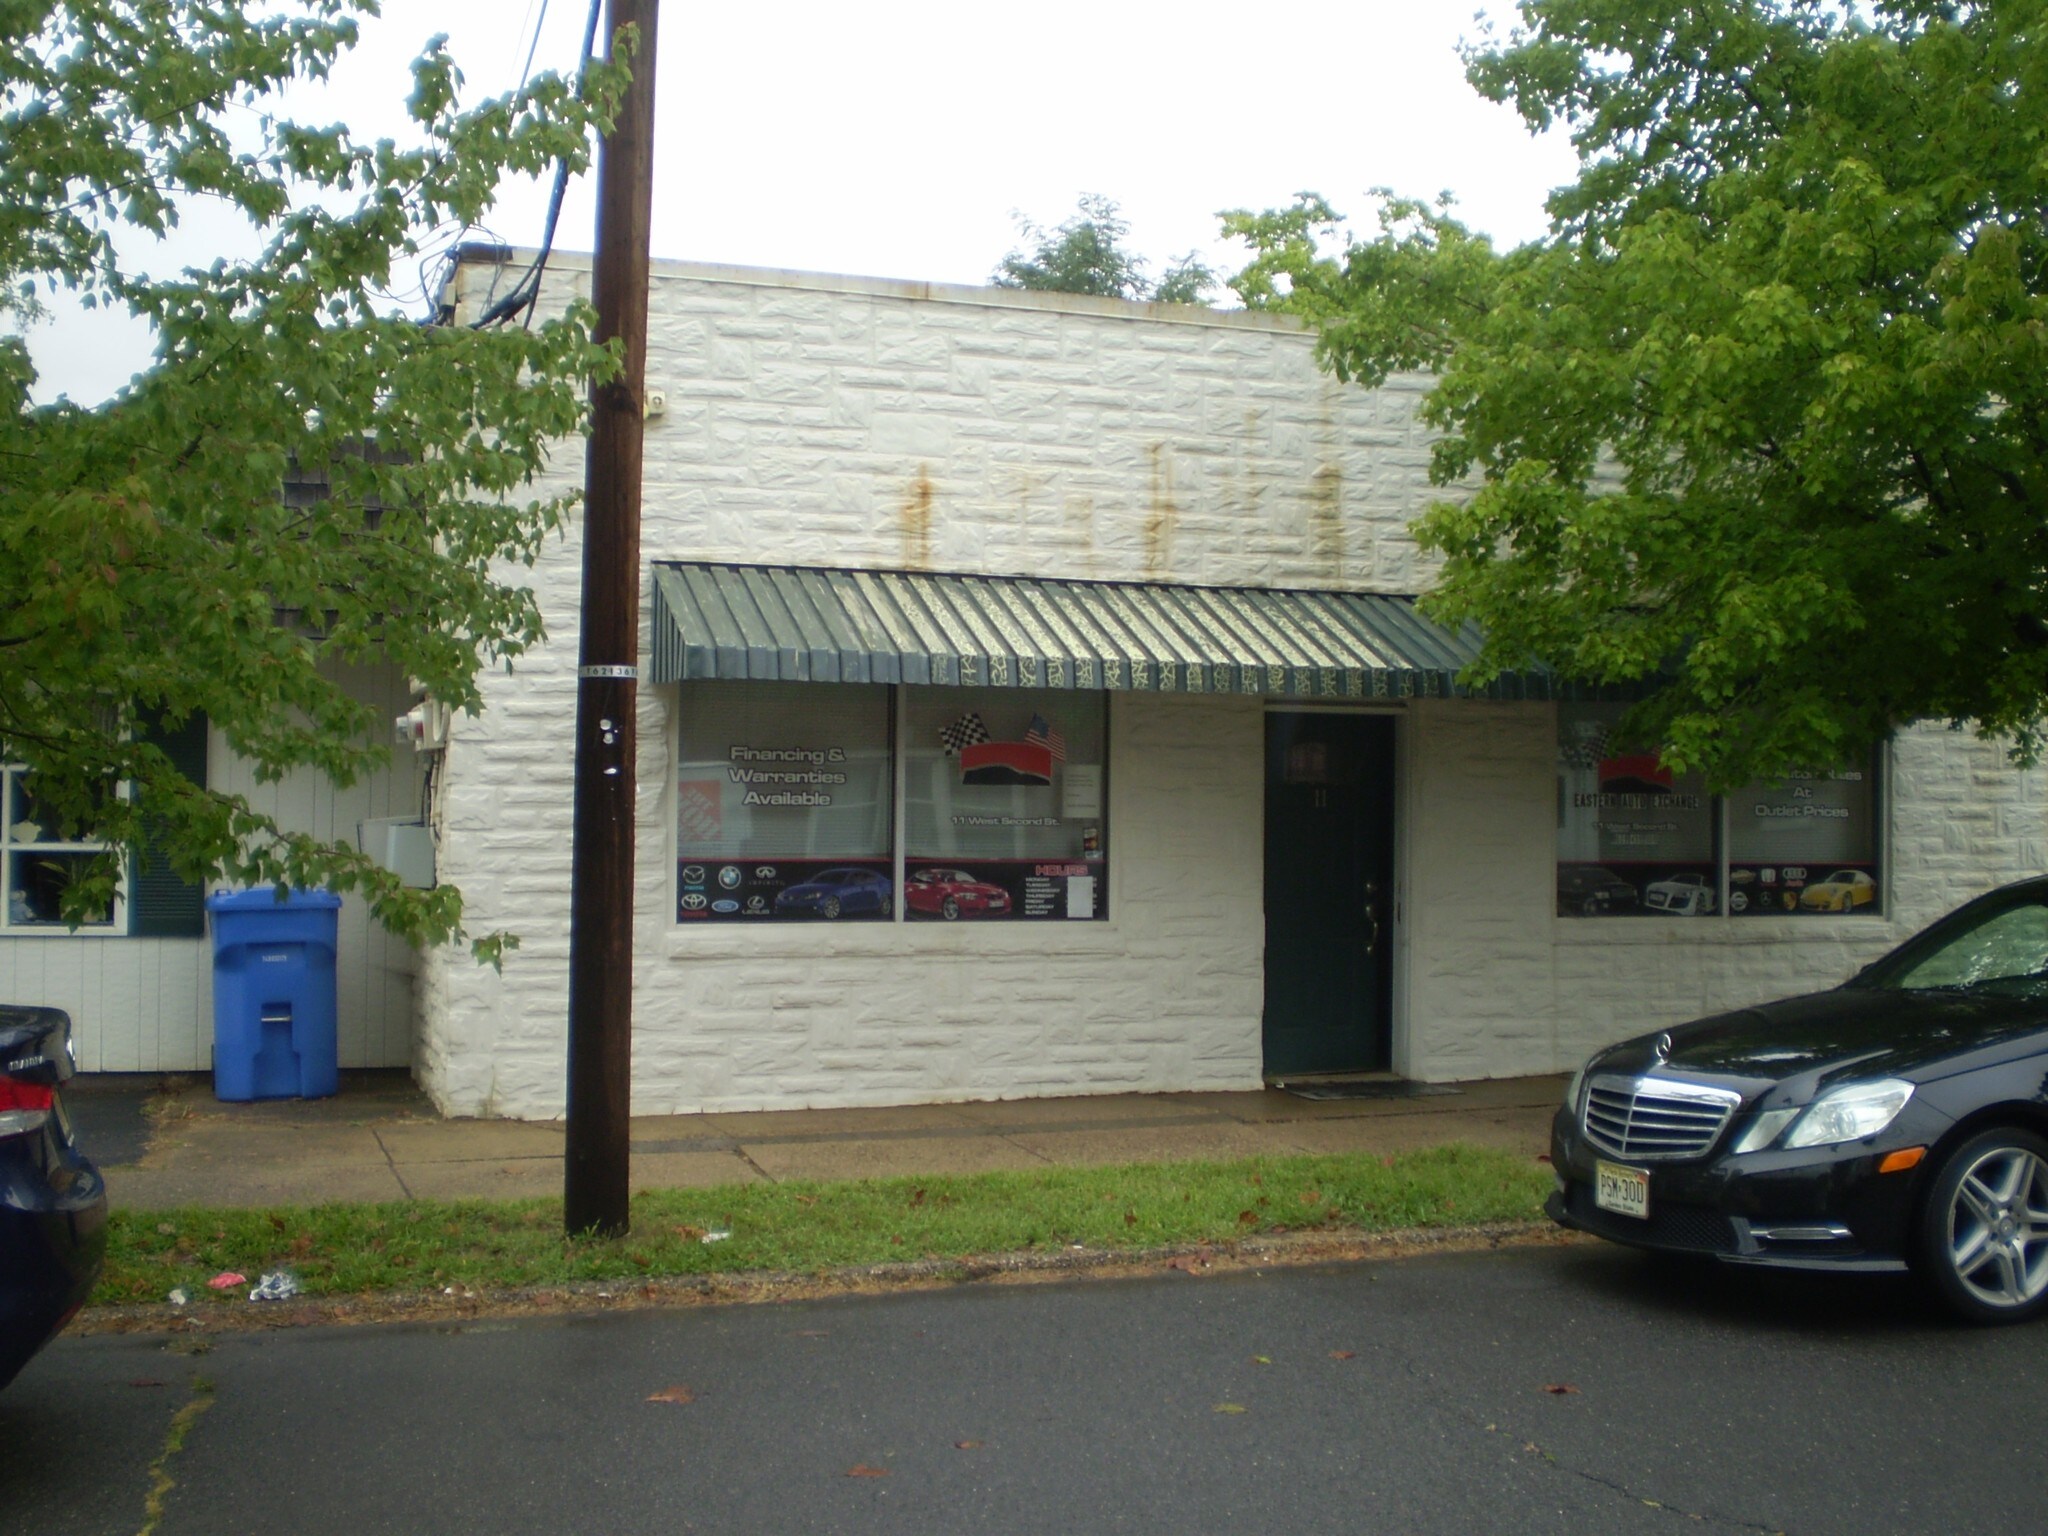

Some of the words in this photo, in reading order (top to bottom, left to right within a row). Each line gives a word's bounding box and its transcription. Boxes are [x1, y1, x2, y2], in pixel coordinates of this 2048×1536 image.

[729, 746, 825, 766] Financing
[827, 748, 847, 763] &
[728, 768, 847, 785] Warranties
[743, 792, 832, 806] Available
[1793, 786, 1813, 799] At
[1754, 804, 1801, 817] Outlet
[1803, 805, 1850, 818] Prices
[952, 816, 965, 824] 11
[968, 816, 999, 825] West
[1001, 817, 1043, 826] Second
[1035, 864, 1089, 877] HOURS
